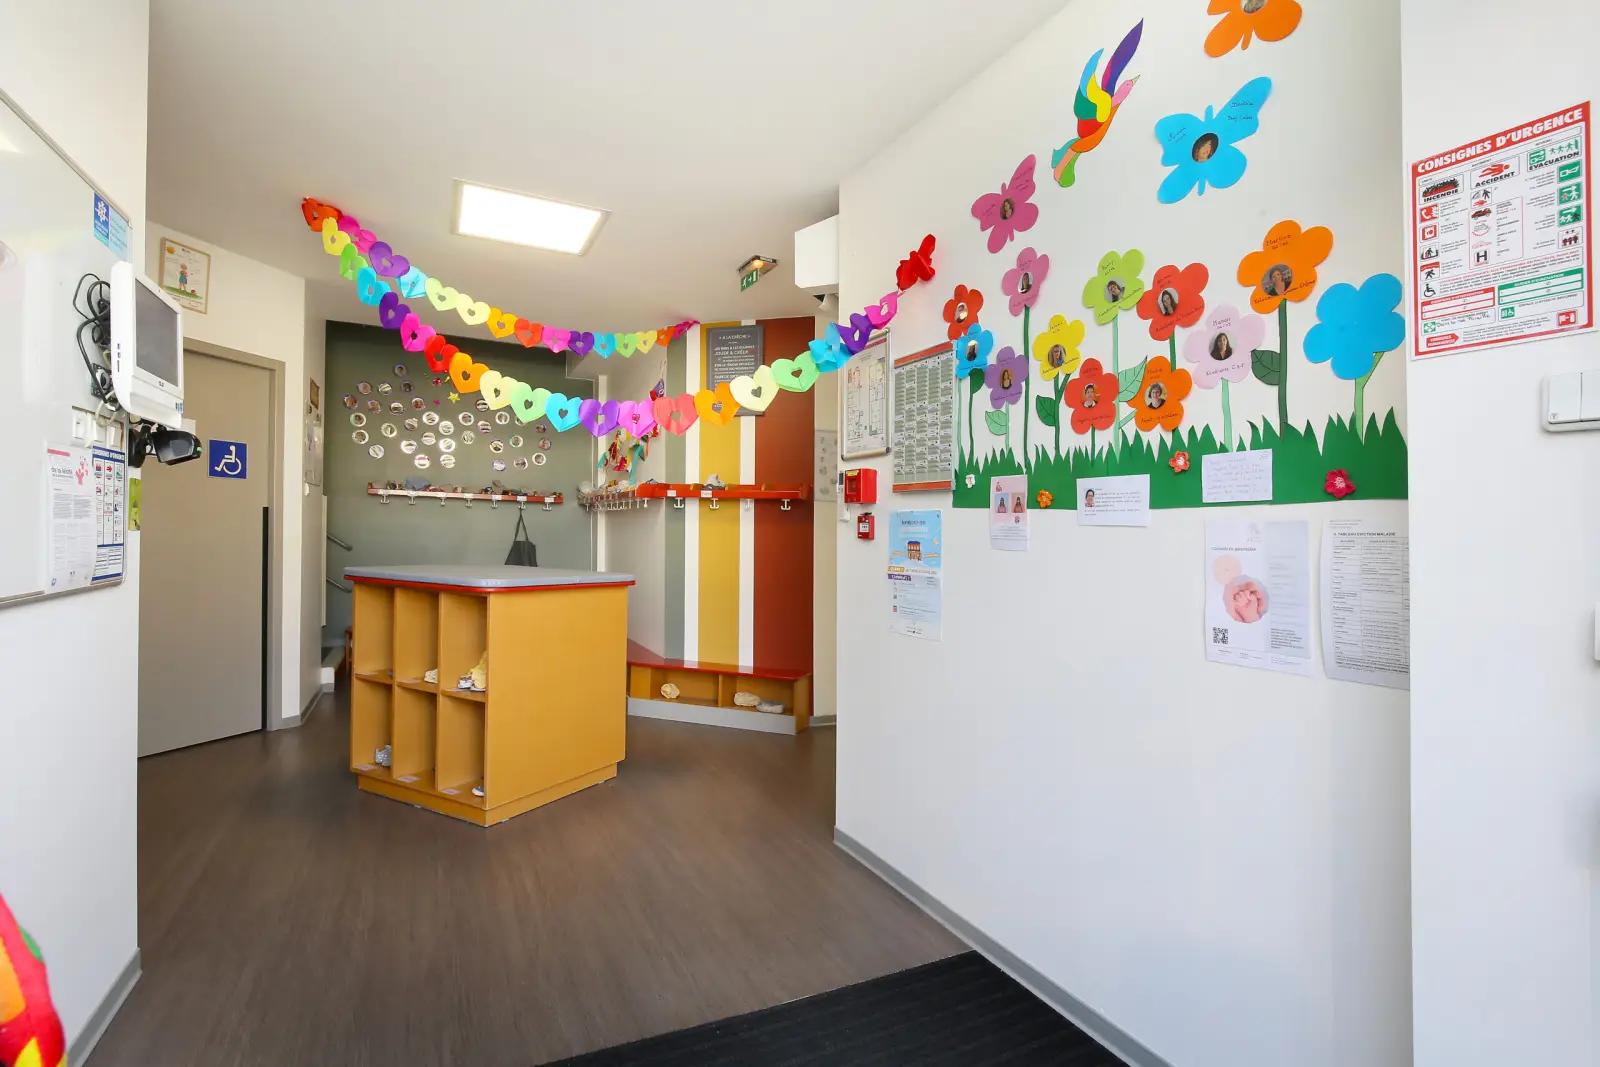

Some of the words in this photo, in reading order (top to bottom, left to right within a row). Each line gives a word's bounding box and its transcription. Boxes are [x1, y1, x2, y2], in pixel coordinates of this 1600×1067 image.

[1417, 140, 1492, 173] CONSIGNES
[1496, 107, 1583, 147] D'URGENCE
[1529, 151, 1580, 171] EVACUATION
[1475, 171, 1515, 188] ACCIDENT
[1423, 188, 1459, 203] INCENDIE
